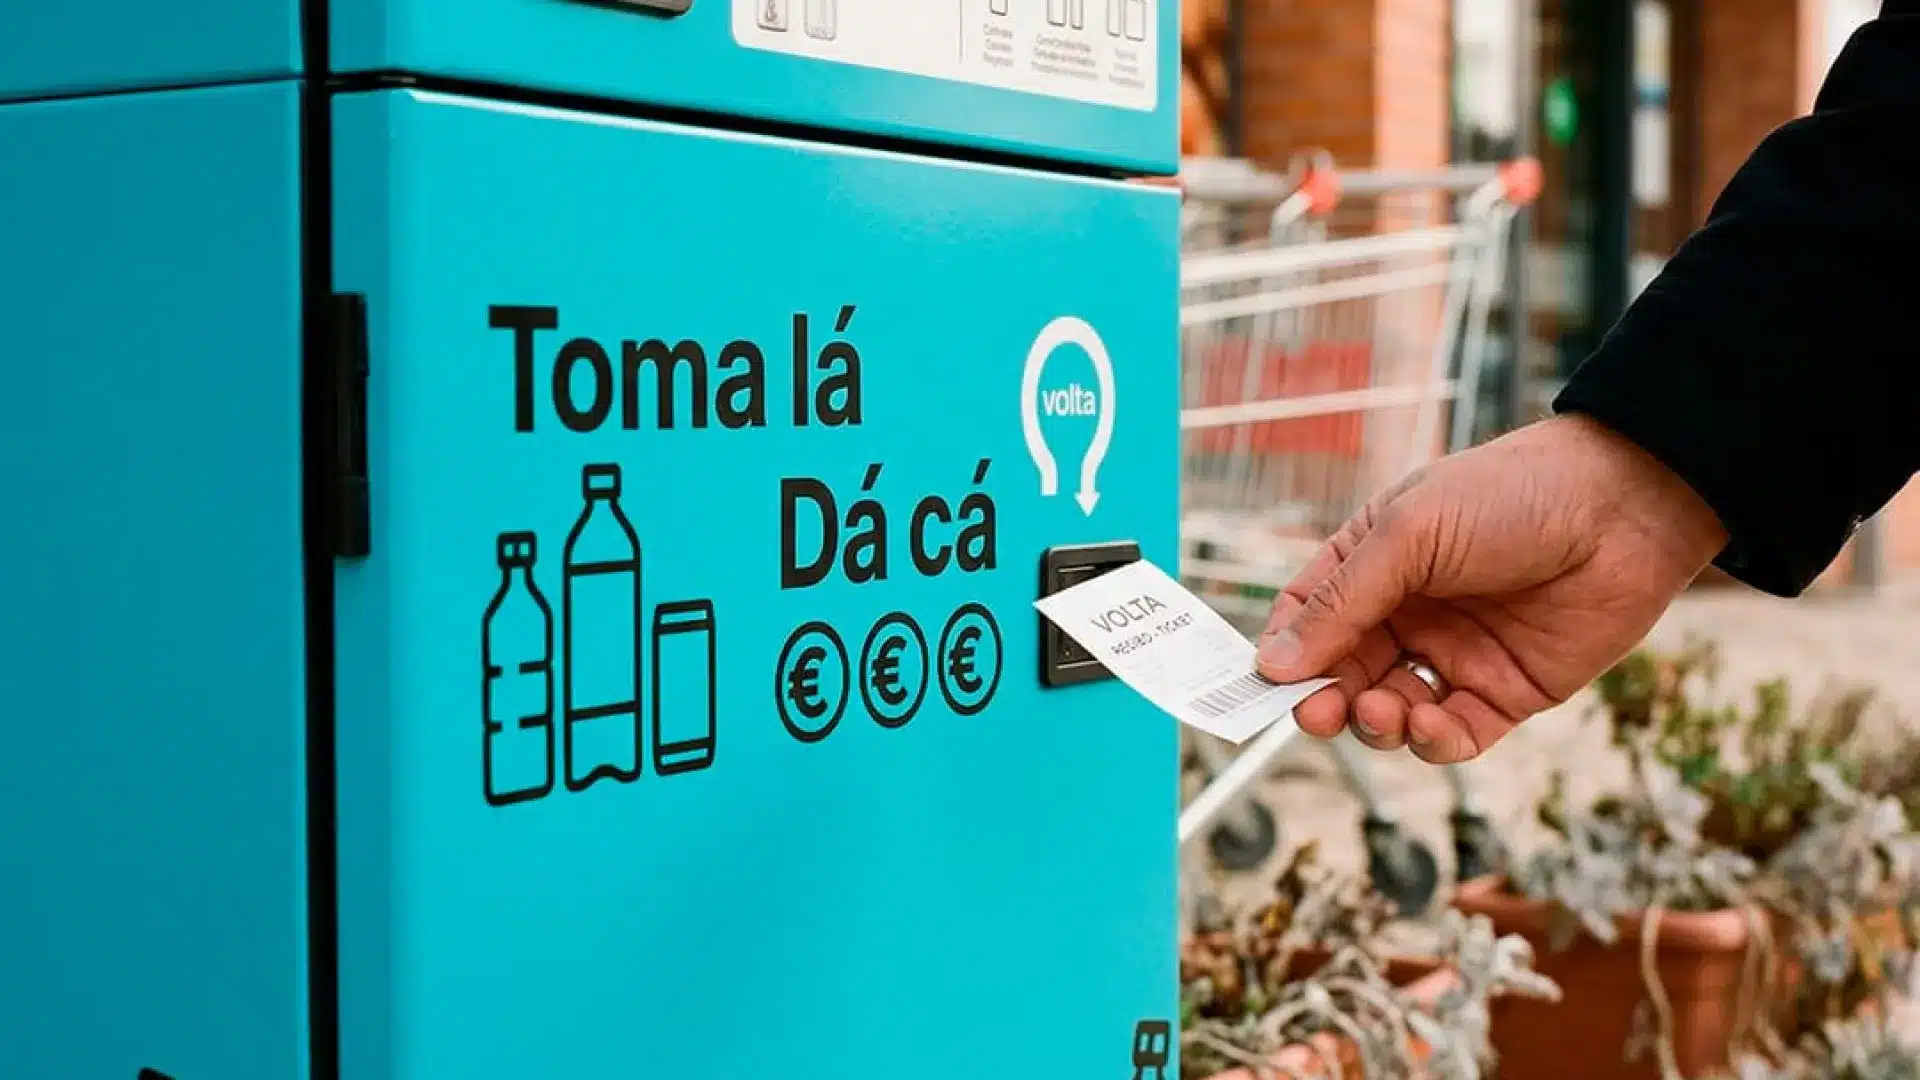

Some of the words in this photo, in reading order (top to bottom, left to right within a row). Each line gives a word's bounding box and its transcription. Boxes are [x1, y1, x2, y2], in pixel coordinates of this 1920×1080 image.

[487, 304, 767, 433] Toma
[792, 305, 863, 428] lá
[1041, 383, 1096, 417] volta
[780, 463, 888, 590] Dá
[909, 458, 997, 577] cá
[1089, 593, 1168, 633] VOLTA
